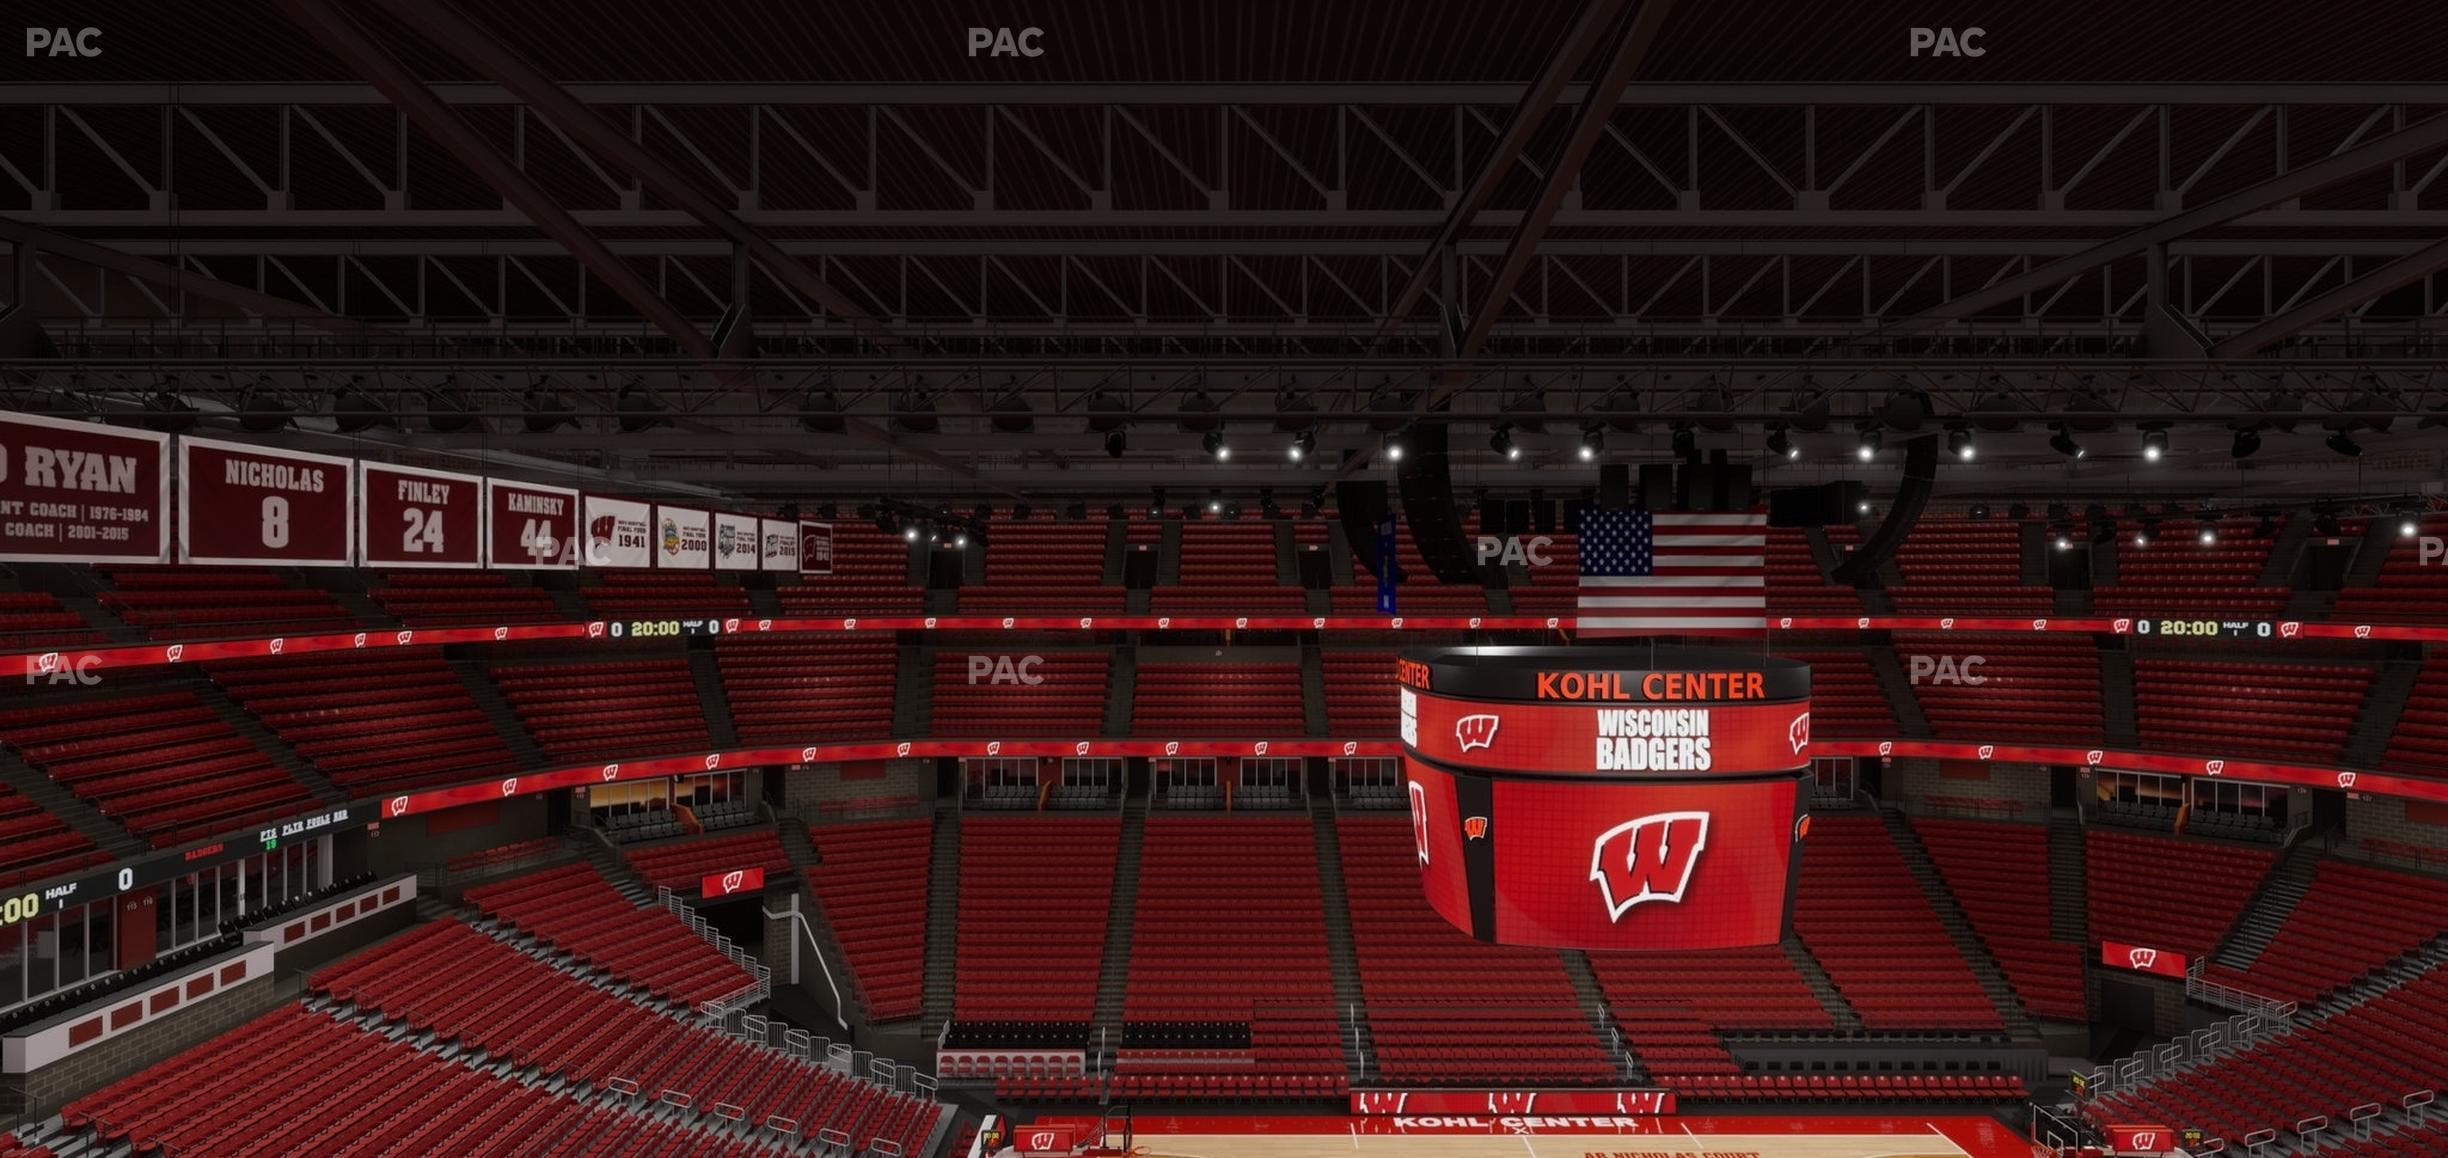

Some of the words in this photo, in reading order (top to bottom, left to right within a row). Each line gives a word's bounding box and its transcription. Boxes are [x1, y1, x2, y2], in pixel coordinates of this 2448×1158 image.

[24, 446, 137, 494] RYAN
[225, 459, 325, 493] NICHOLAS
[397, 479, 451, 505] FINLEY
[30, 502, 77, 519] COACH
[90, 506, 149, 522] 1976-1984
[508, 492, 564, 516] KAMINSKY
[5, 522, 55, 539] COACH
[68, 524, 129, 542] 2001-2015
[261, 495, 289, 549] 8
[402, 507, 445, 553] 24
[520, 518, 552, 558] 44
[618, 534, 646, 548] 1941
[681, 539, 707, 551] 2000
[736, 542, 756, 555] 2014
[611, 621, 623, 637] 0
[631, 620, 680, 637] 20:00
[682, 620, 703, 629] HALF
[708, 619, 720, 635] 0
[2137, 619, 2150, 634] 0
[2160, 620, 2218, 636] 20:00
[2222, 621, 2249, 629] HALF
[2257, 622, 2271, 637] 0
[1537, 672, 1630, 700] KOHL
[1642, 672, 1766, 700] CENTER
[1597, 709, 1710, 738] WISCONSIN
[1596, 738, 1712, 771] BADGERS
[260, 828, 278, 842] PTS
[1588, 811, 1710, 923] W
[118, 867, 134, 891] 0
[45, 882, 78, 900] HALF
[1393, 1116, 1489, 1128] KOHL
[1500, 1116, 1640, 1128] CENTER
